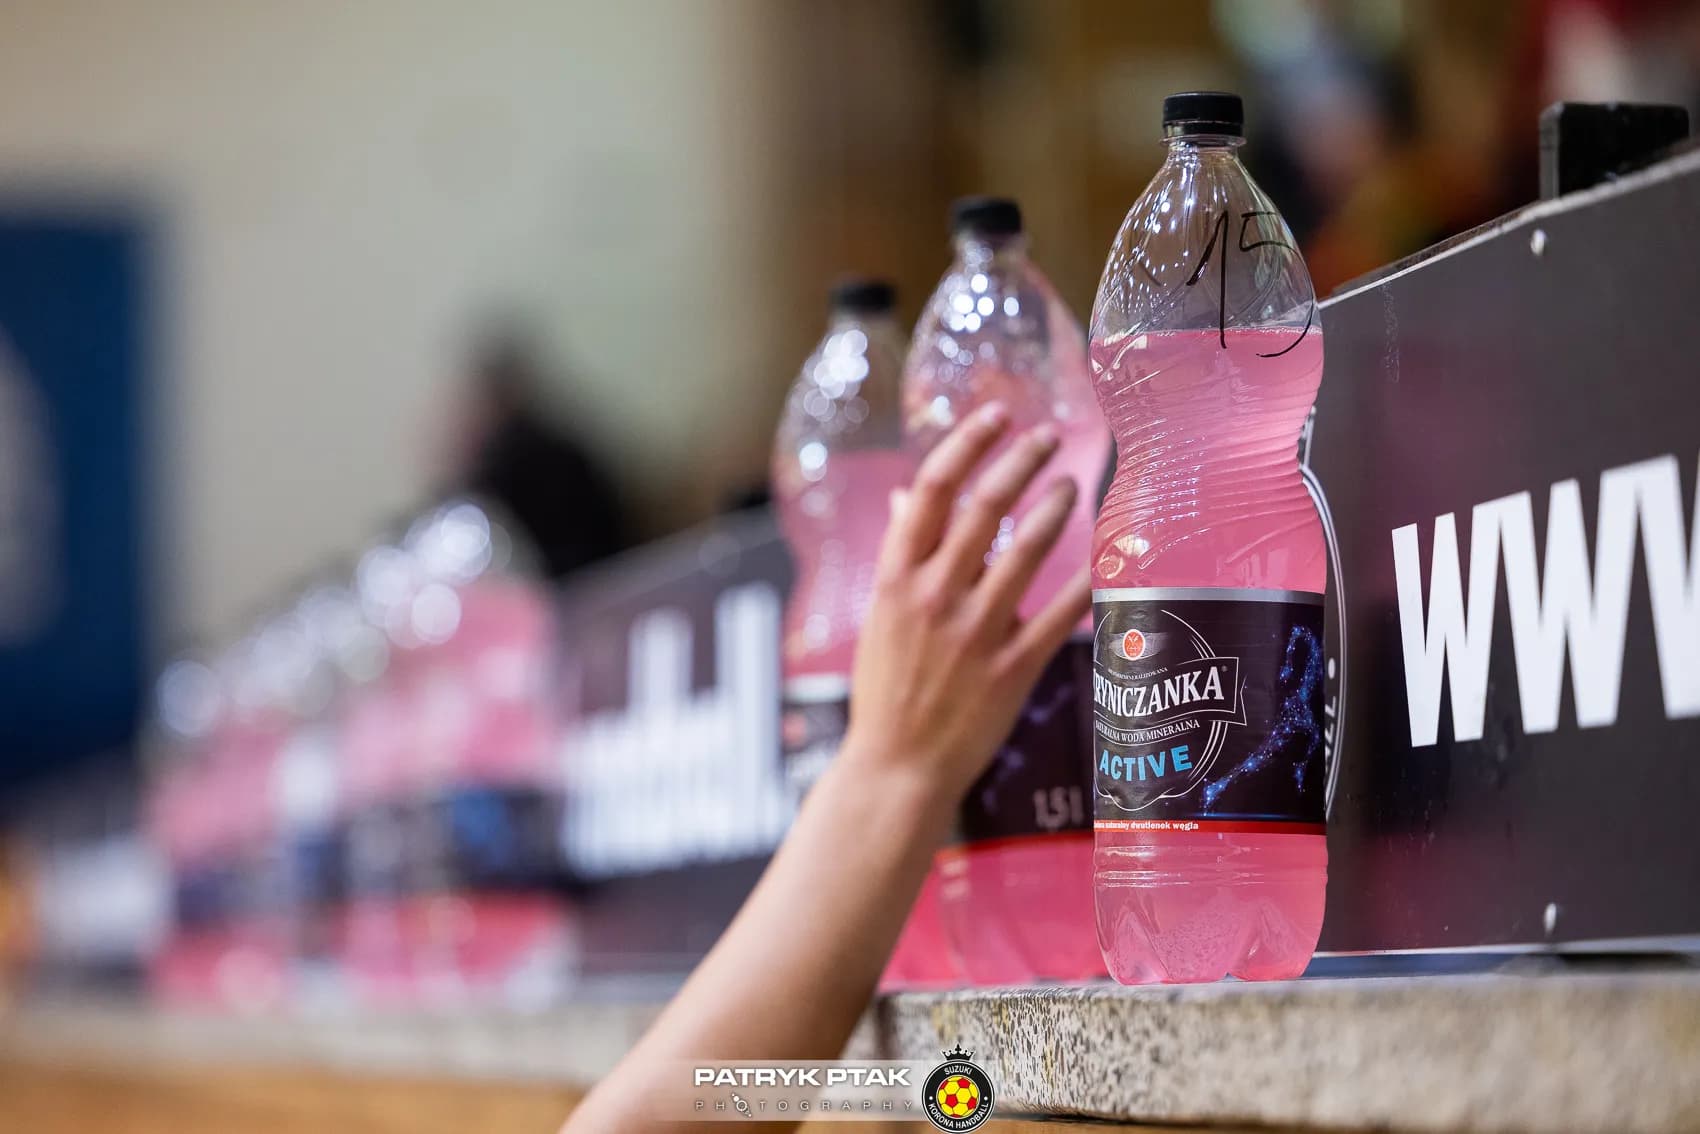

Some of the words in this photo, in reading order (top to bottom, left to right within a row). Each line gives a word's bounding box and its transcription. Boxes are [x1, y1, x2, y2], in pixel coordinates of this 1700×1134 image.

[1186, 209, 1314, 358] 15
[1093, 666, 1225, 717] RYNICZANKA
[1121, 729, 1145, 743] WODA
[1146, 720, 1201, 741] MINERALNA
[1099, 745, 1193, 782] ACTIVE
[1173, 821, 1199, 831] węgla
